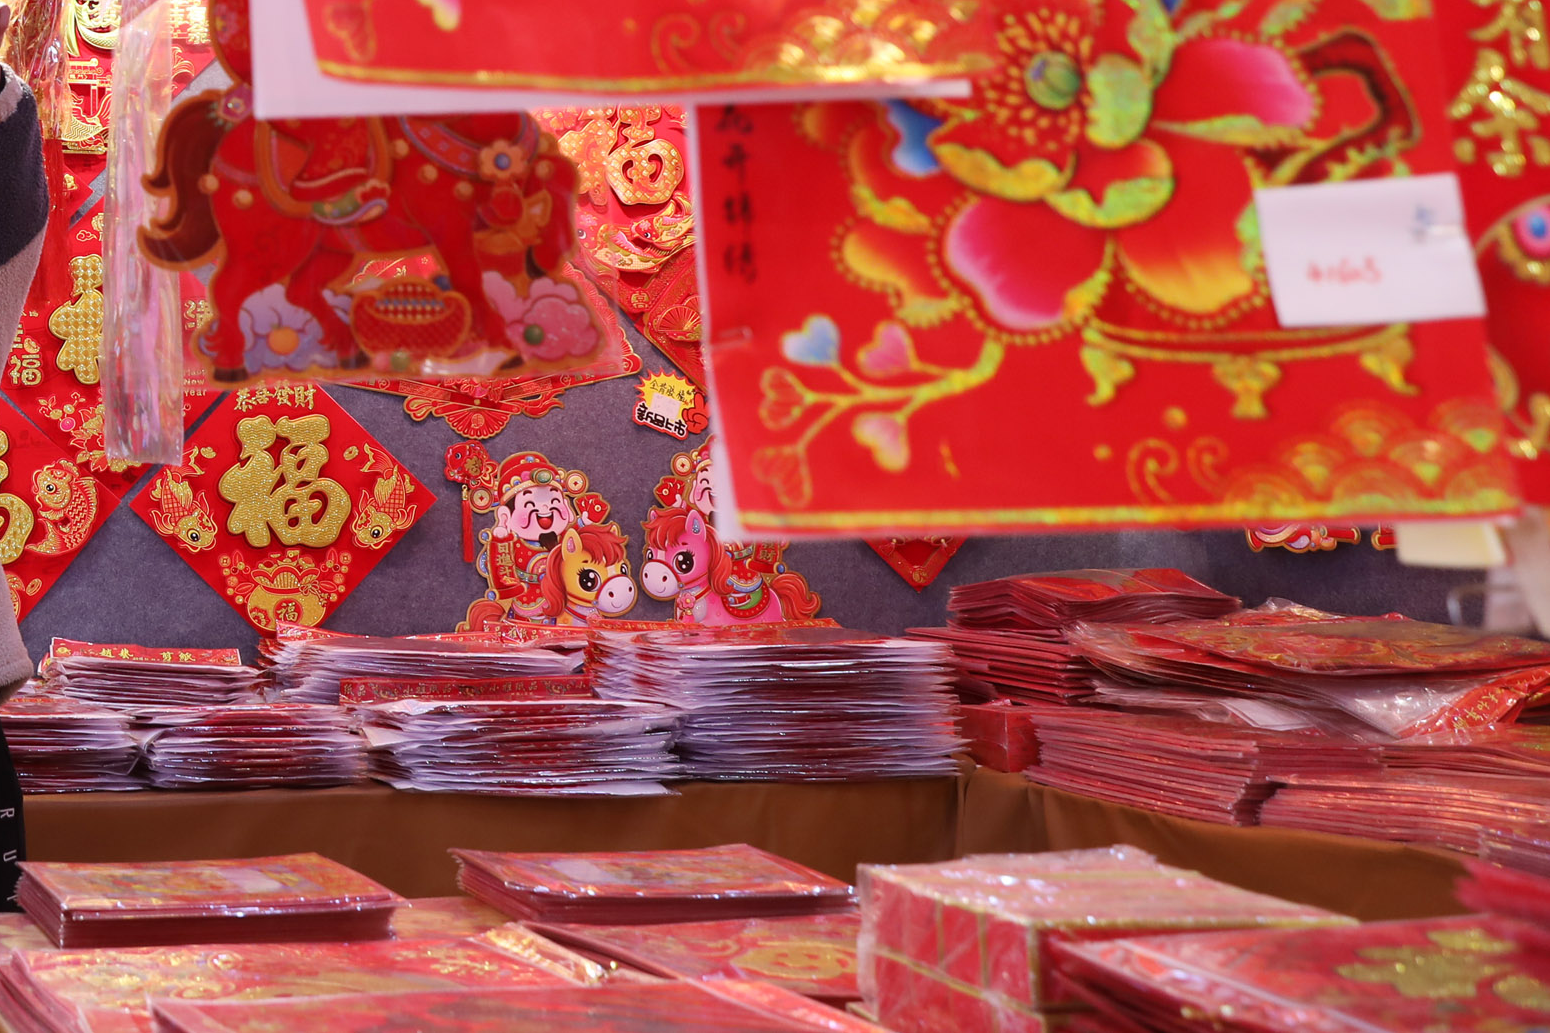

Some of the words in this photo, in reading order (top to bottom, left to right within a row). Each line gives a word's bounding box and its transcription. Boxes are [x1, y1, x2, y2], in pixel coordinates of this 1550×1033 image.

[234, 383, 317, 412] 恭喜發財
[636, 402, 686, 437] 新品上市
[219, 414, 352, 548] 福
[275, 601, 299, 623] 福
